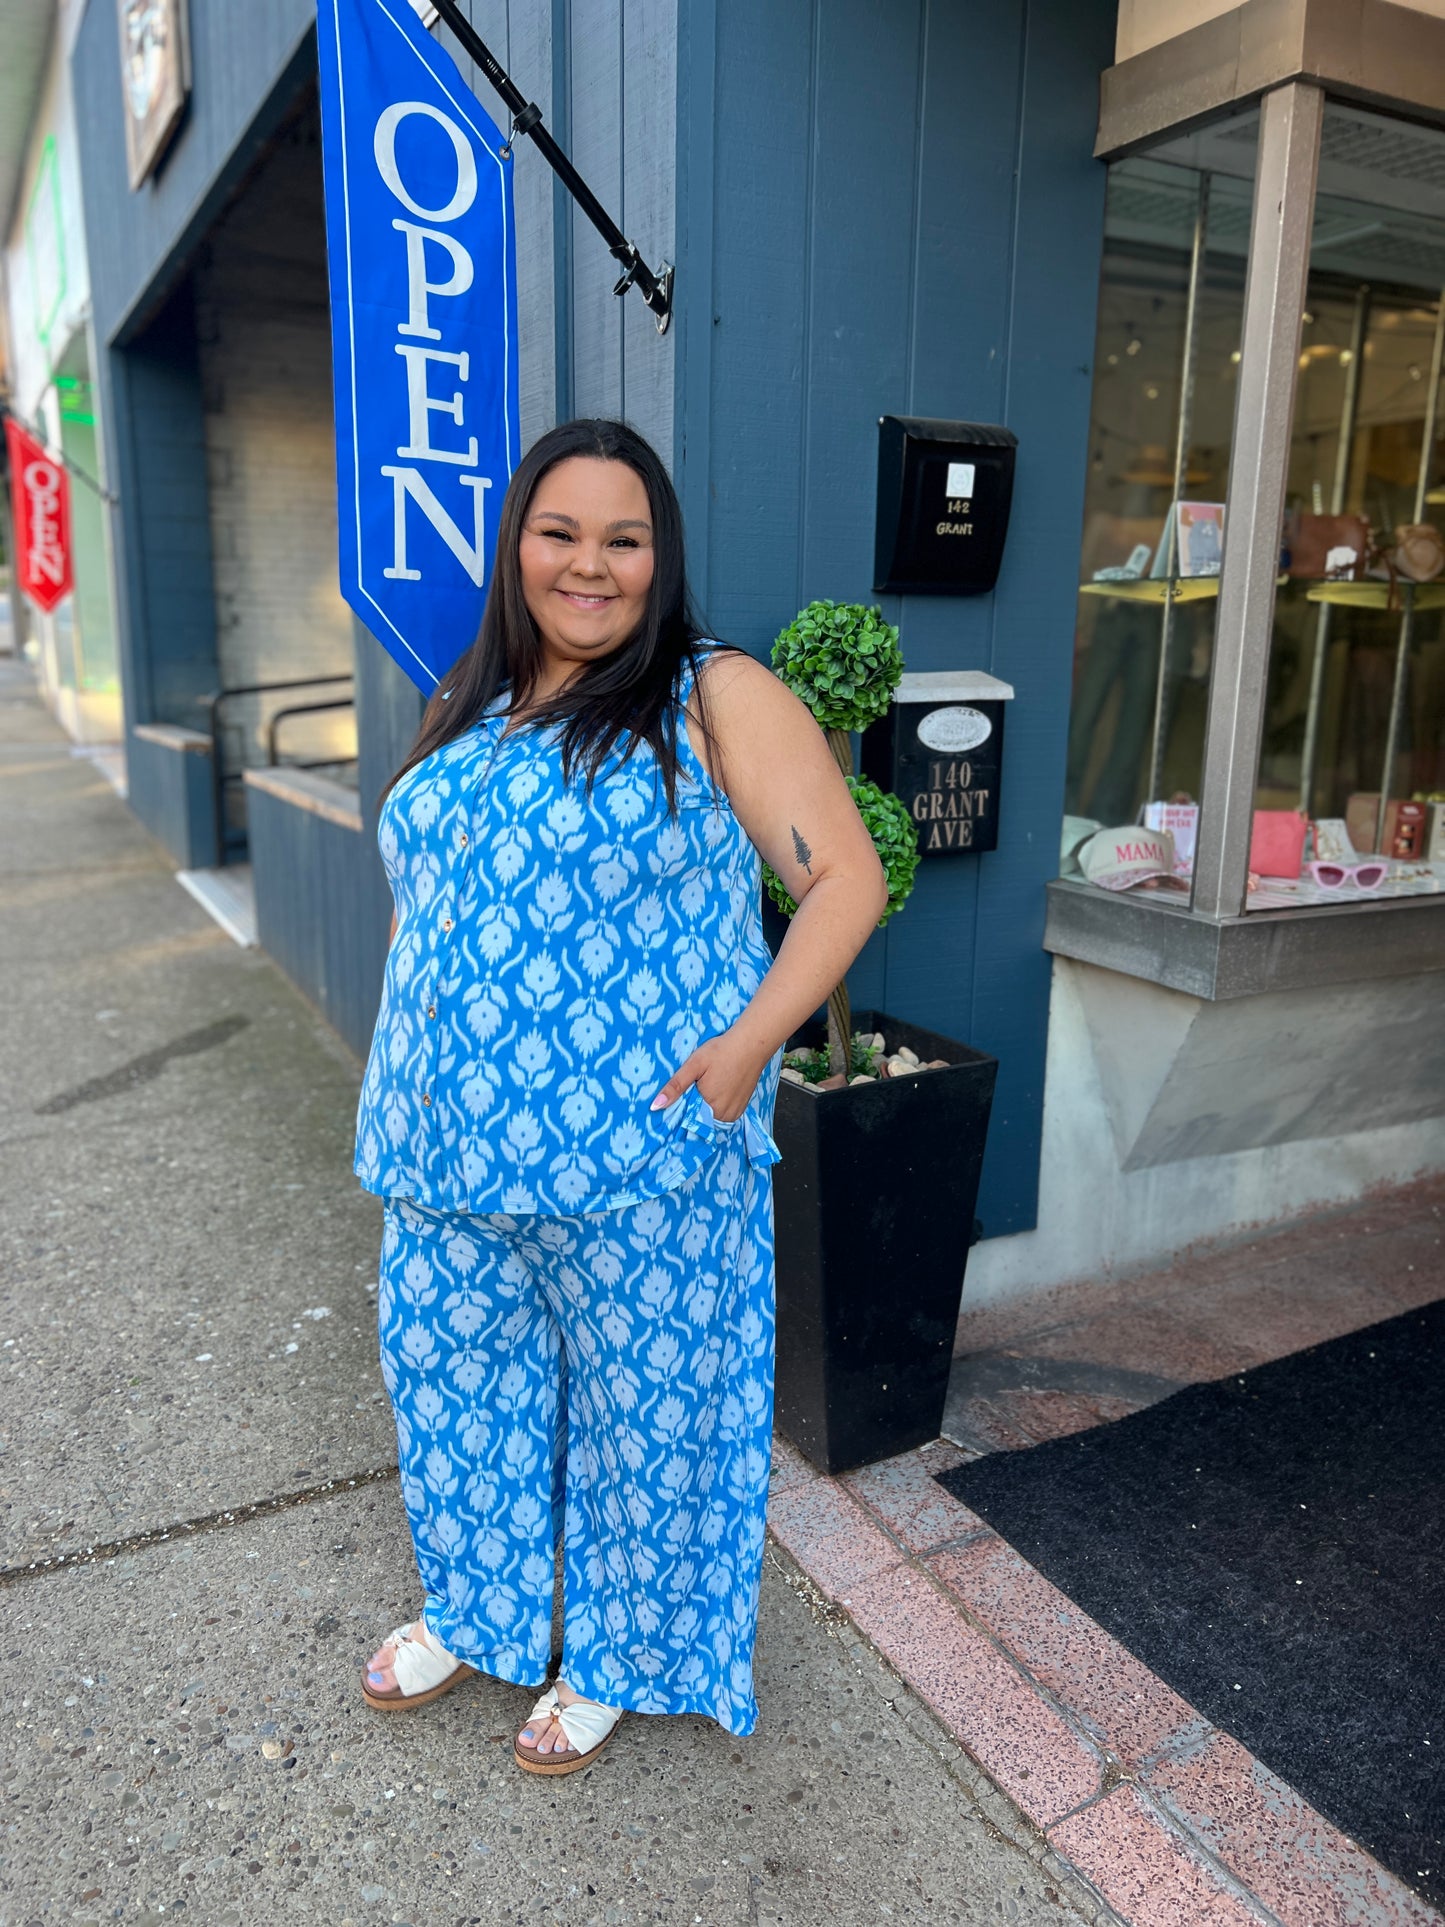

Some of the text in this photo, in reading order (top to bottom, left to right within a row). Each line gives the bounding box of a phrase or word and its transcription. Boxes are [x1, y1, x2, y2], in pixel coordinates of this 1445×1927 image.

[373, 101, 492, 588] OPEN
[948, 500, 970, 513] 142
[24, 461, 64, 585] OPEN
[936, 522, 973, 535] GRANT
[932, 761, 972, 790] 140
[913, 789, 989, 821] GRANT
[927, 820, 973, 849] AVE
[1115, 842, 1165, 864] MAMA
